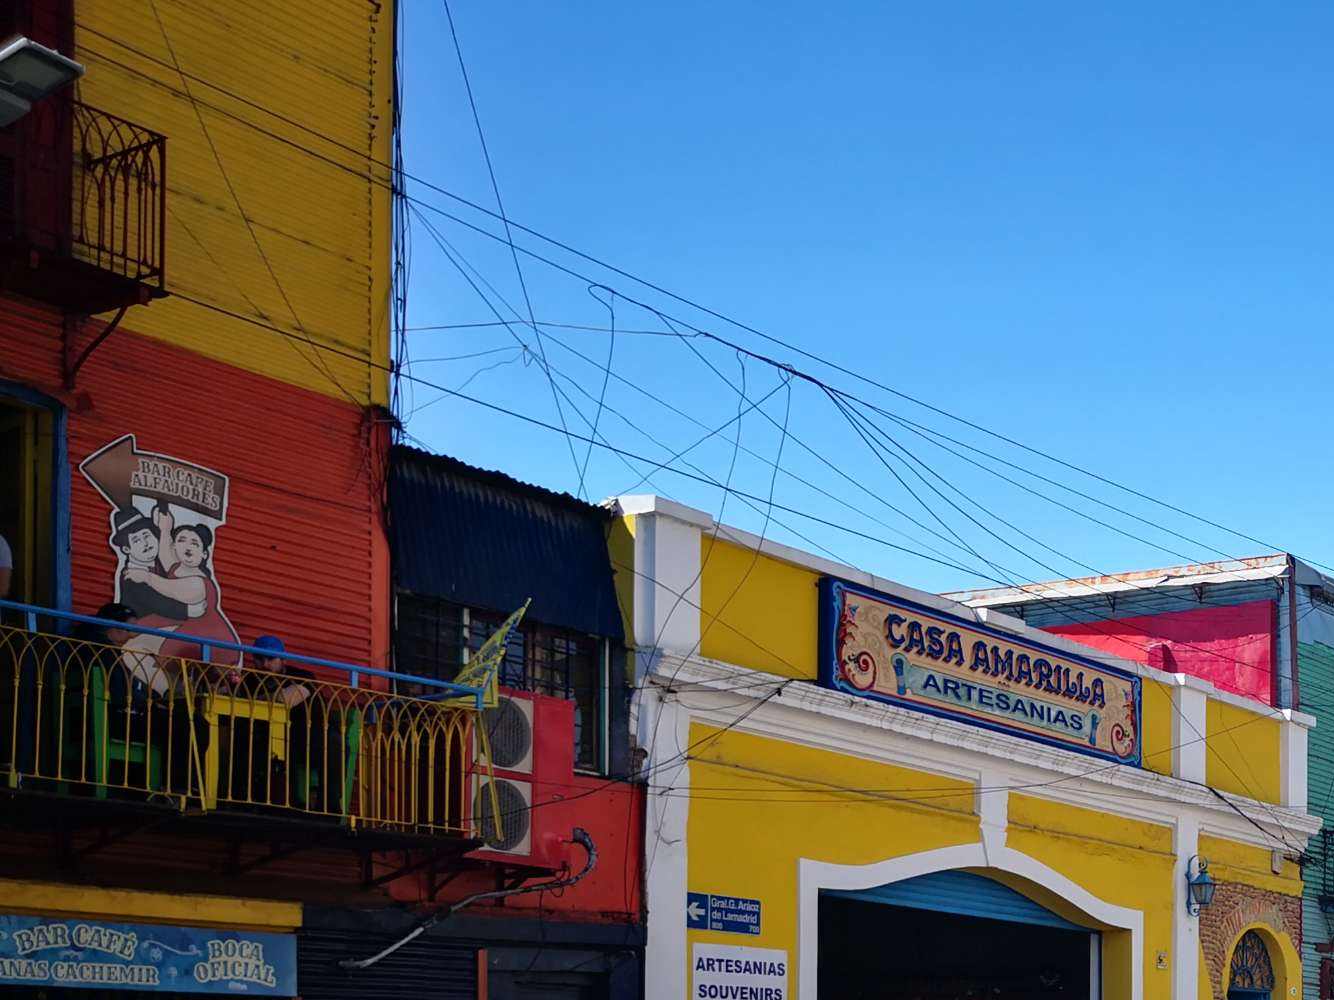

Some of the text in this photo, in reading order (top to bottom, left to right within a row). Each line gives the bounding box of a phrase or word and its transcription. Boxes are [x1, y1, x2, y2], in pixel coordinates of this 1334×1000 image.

[140, 459, 172, 478] BAR
[131, 472, 220, 510] ALFAJORES
[884, 614, 1107, 709] CASA AMARILLA
[922, 673, 1084, 731] ARTESANIAS
[711, 910, 758, 924] de Lamadrid
[13, 924, 138, 961] BAR CAFÉ
[207, 939, 264, 961] BOCA
[51, 960, 160, 985] CACHEMIR
[194, 959, 277, 987] OFICIAL
[696, 957, 786, 977] ARTESANIAS
